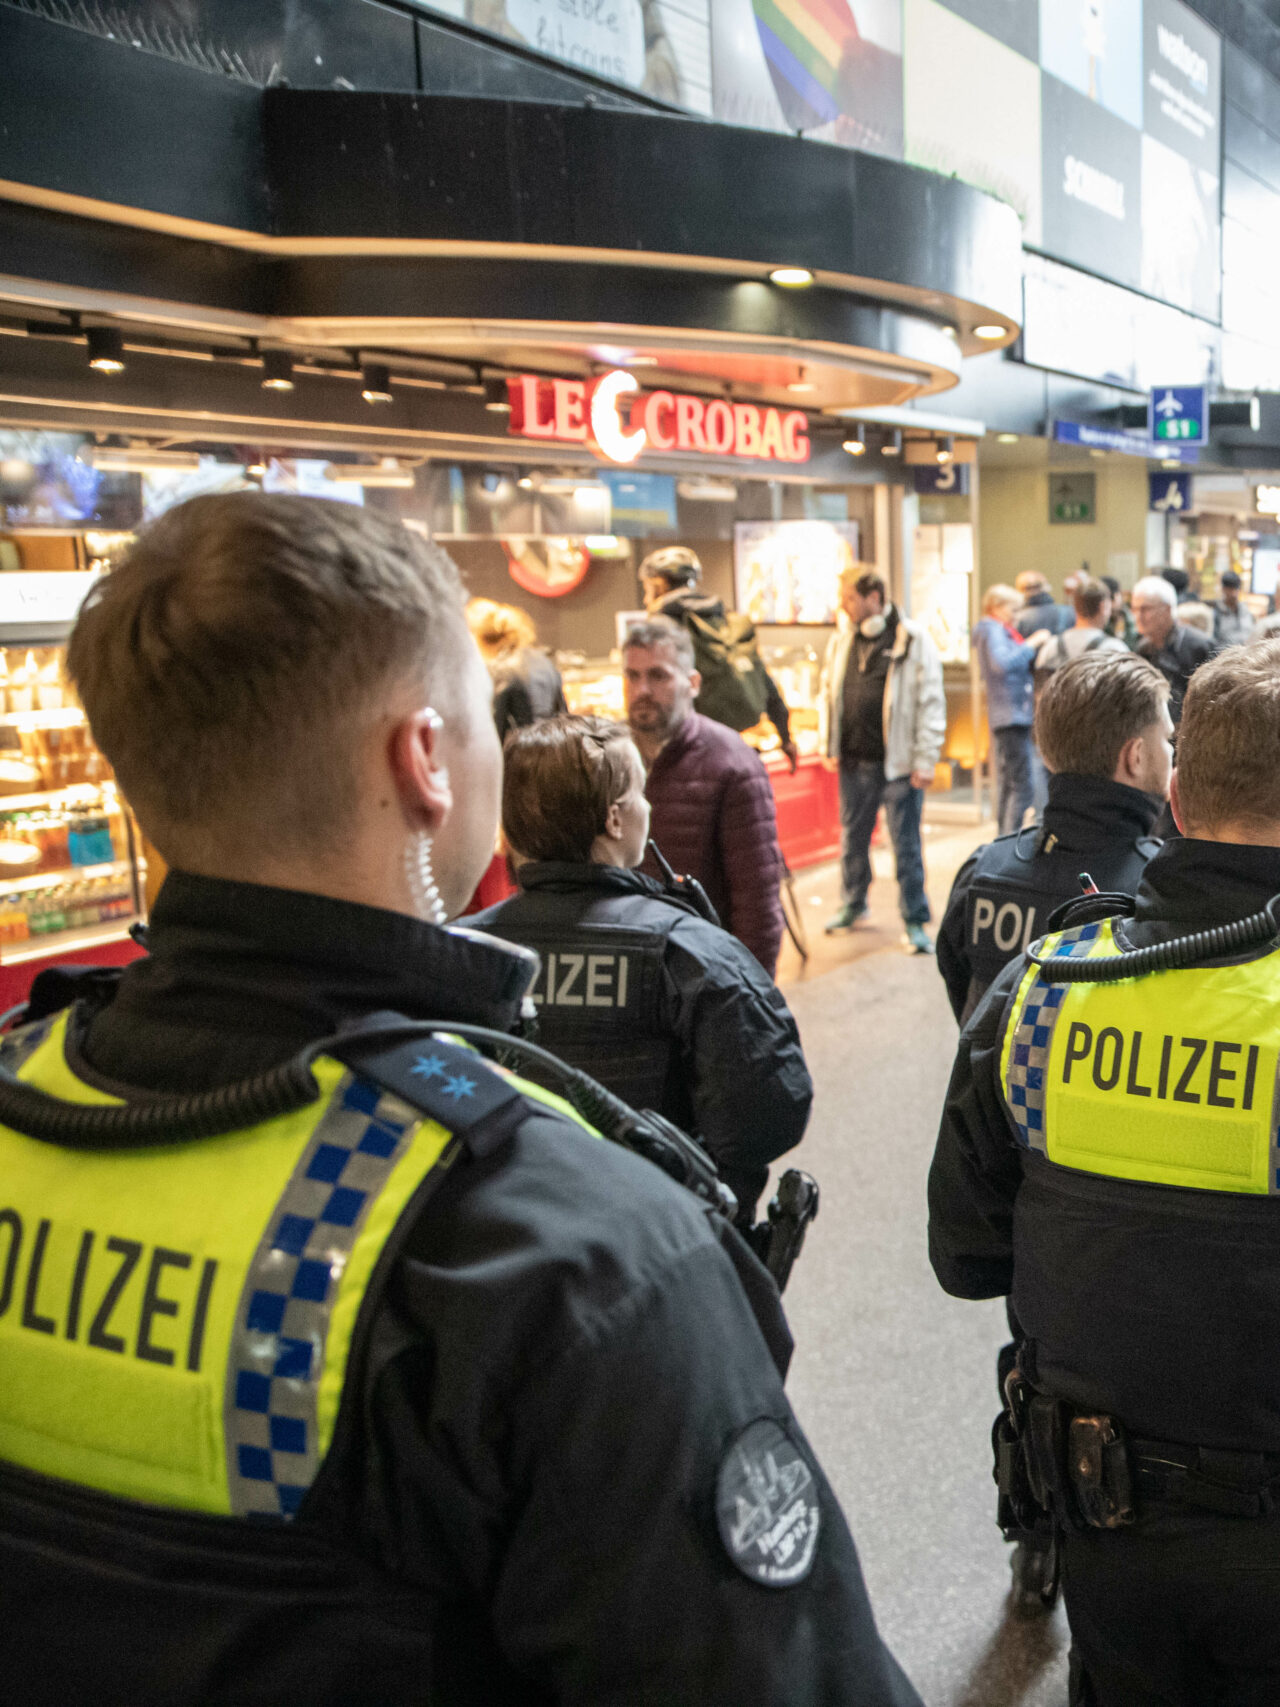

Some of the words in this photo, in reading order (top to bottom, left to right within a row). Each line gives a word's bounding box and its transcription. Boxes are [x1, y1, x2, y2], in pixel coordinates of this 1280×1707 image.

[521, 374, 588, 441] LE
[645, 390, 809, 463] CROBAG
[1166, 419, 1190, 438] S1
[1063, 1022, 1260, 1110] POLIZEI
